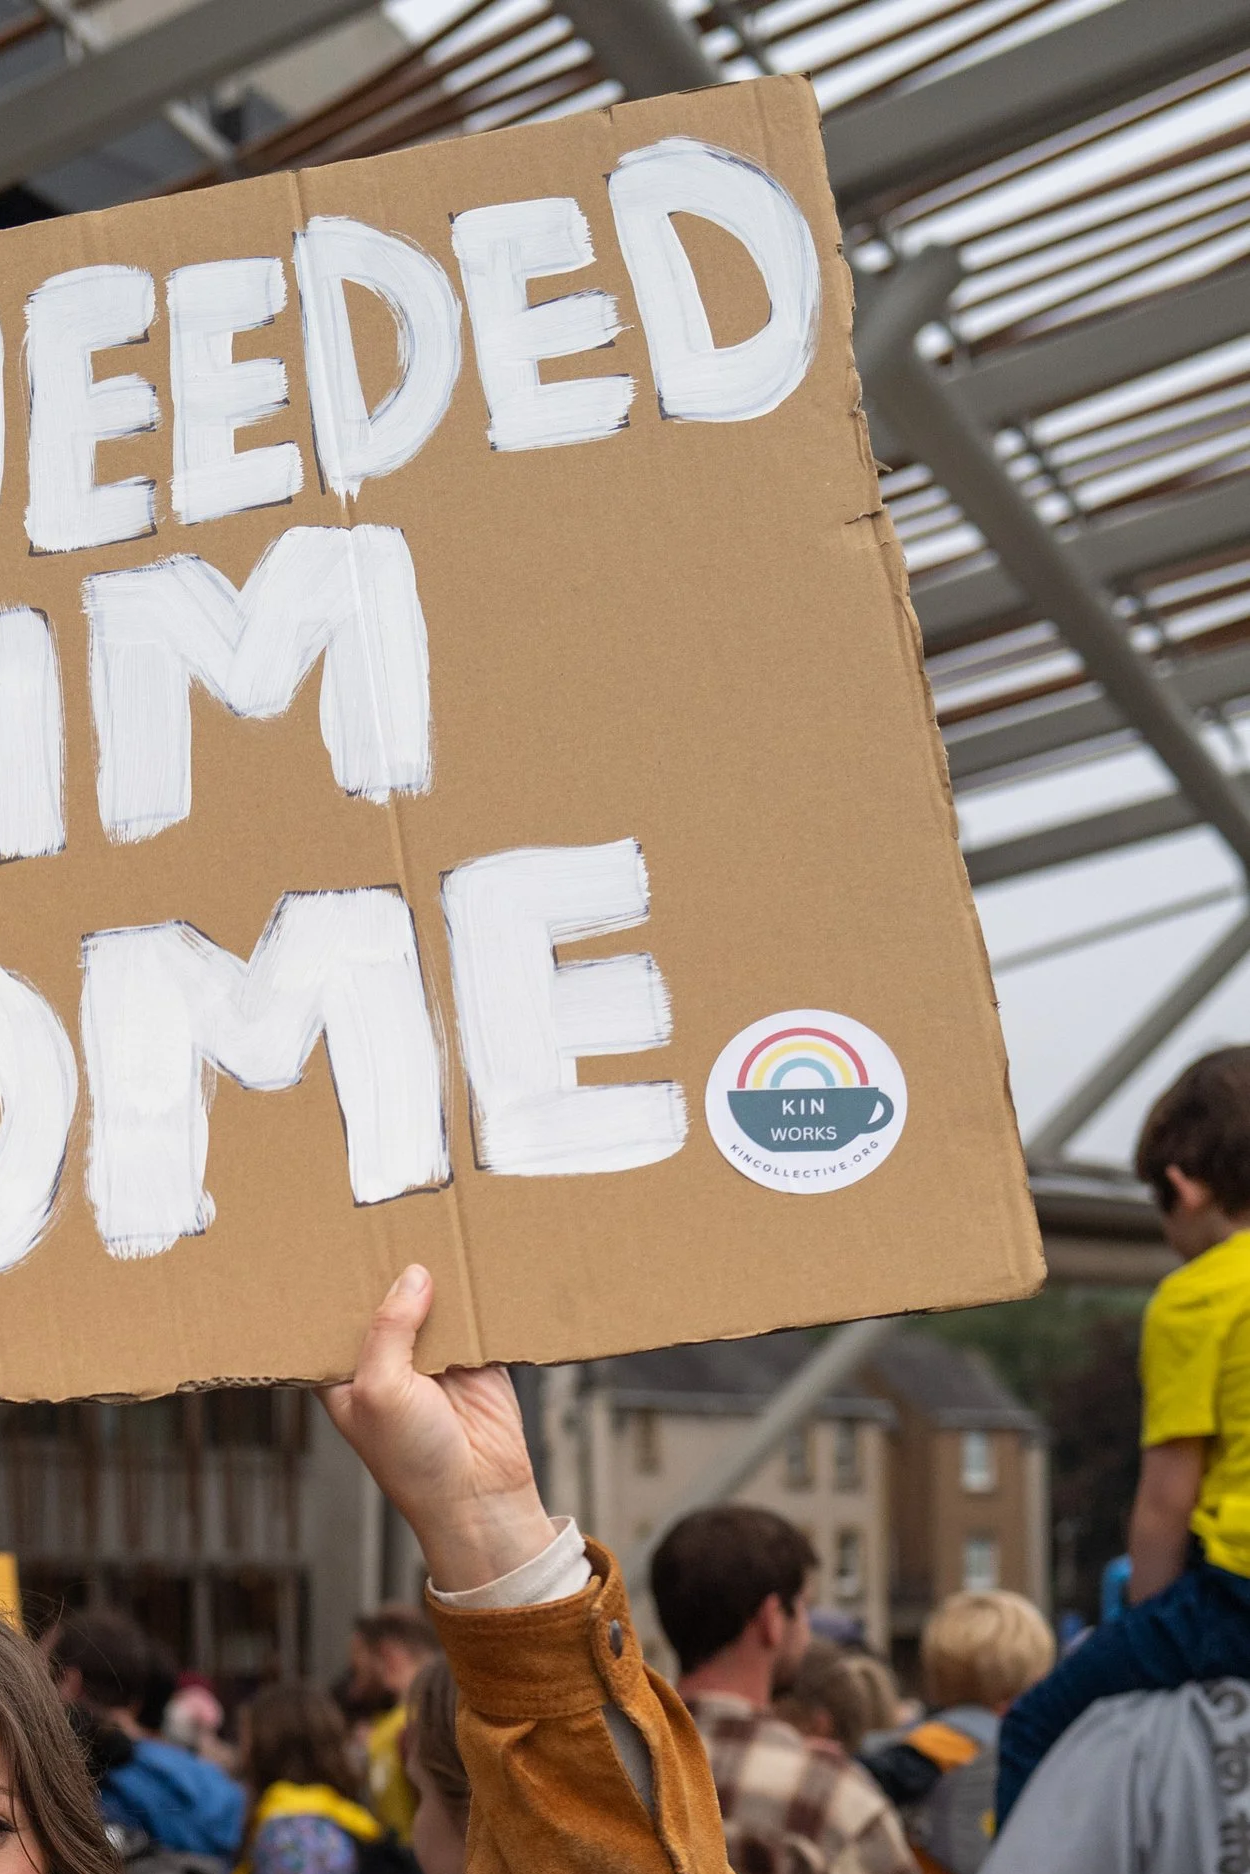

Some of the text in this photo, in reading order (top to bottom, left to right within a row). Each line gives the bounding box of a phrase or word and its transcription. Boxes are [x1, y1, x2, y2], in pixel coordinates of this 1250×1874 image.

[782, 1098, 825, 1116] KIN
[770, 1126, 838, 1142] WORKS
[729, 1139, 879, 1179] KINCOLLECTIVE.ORG
